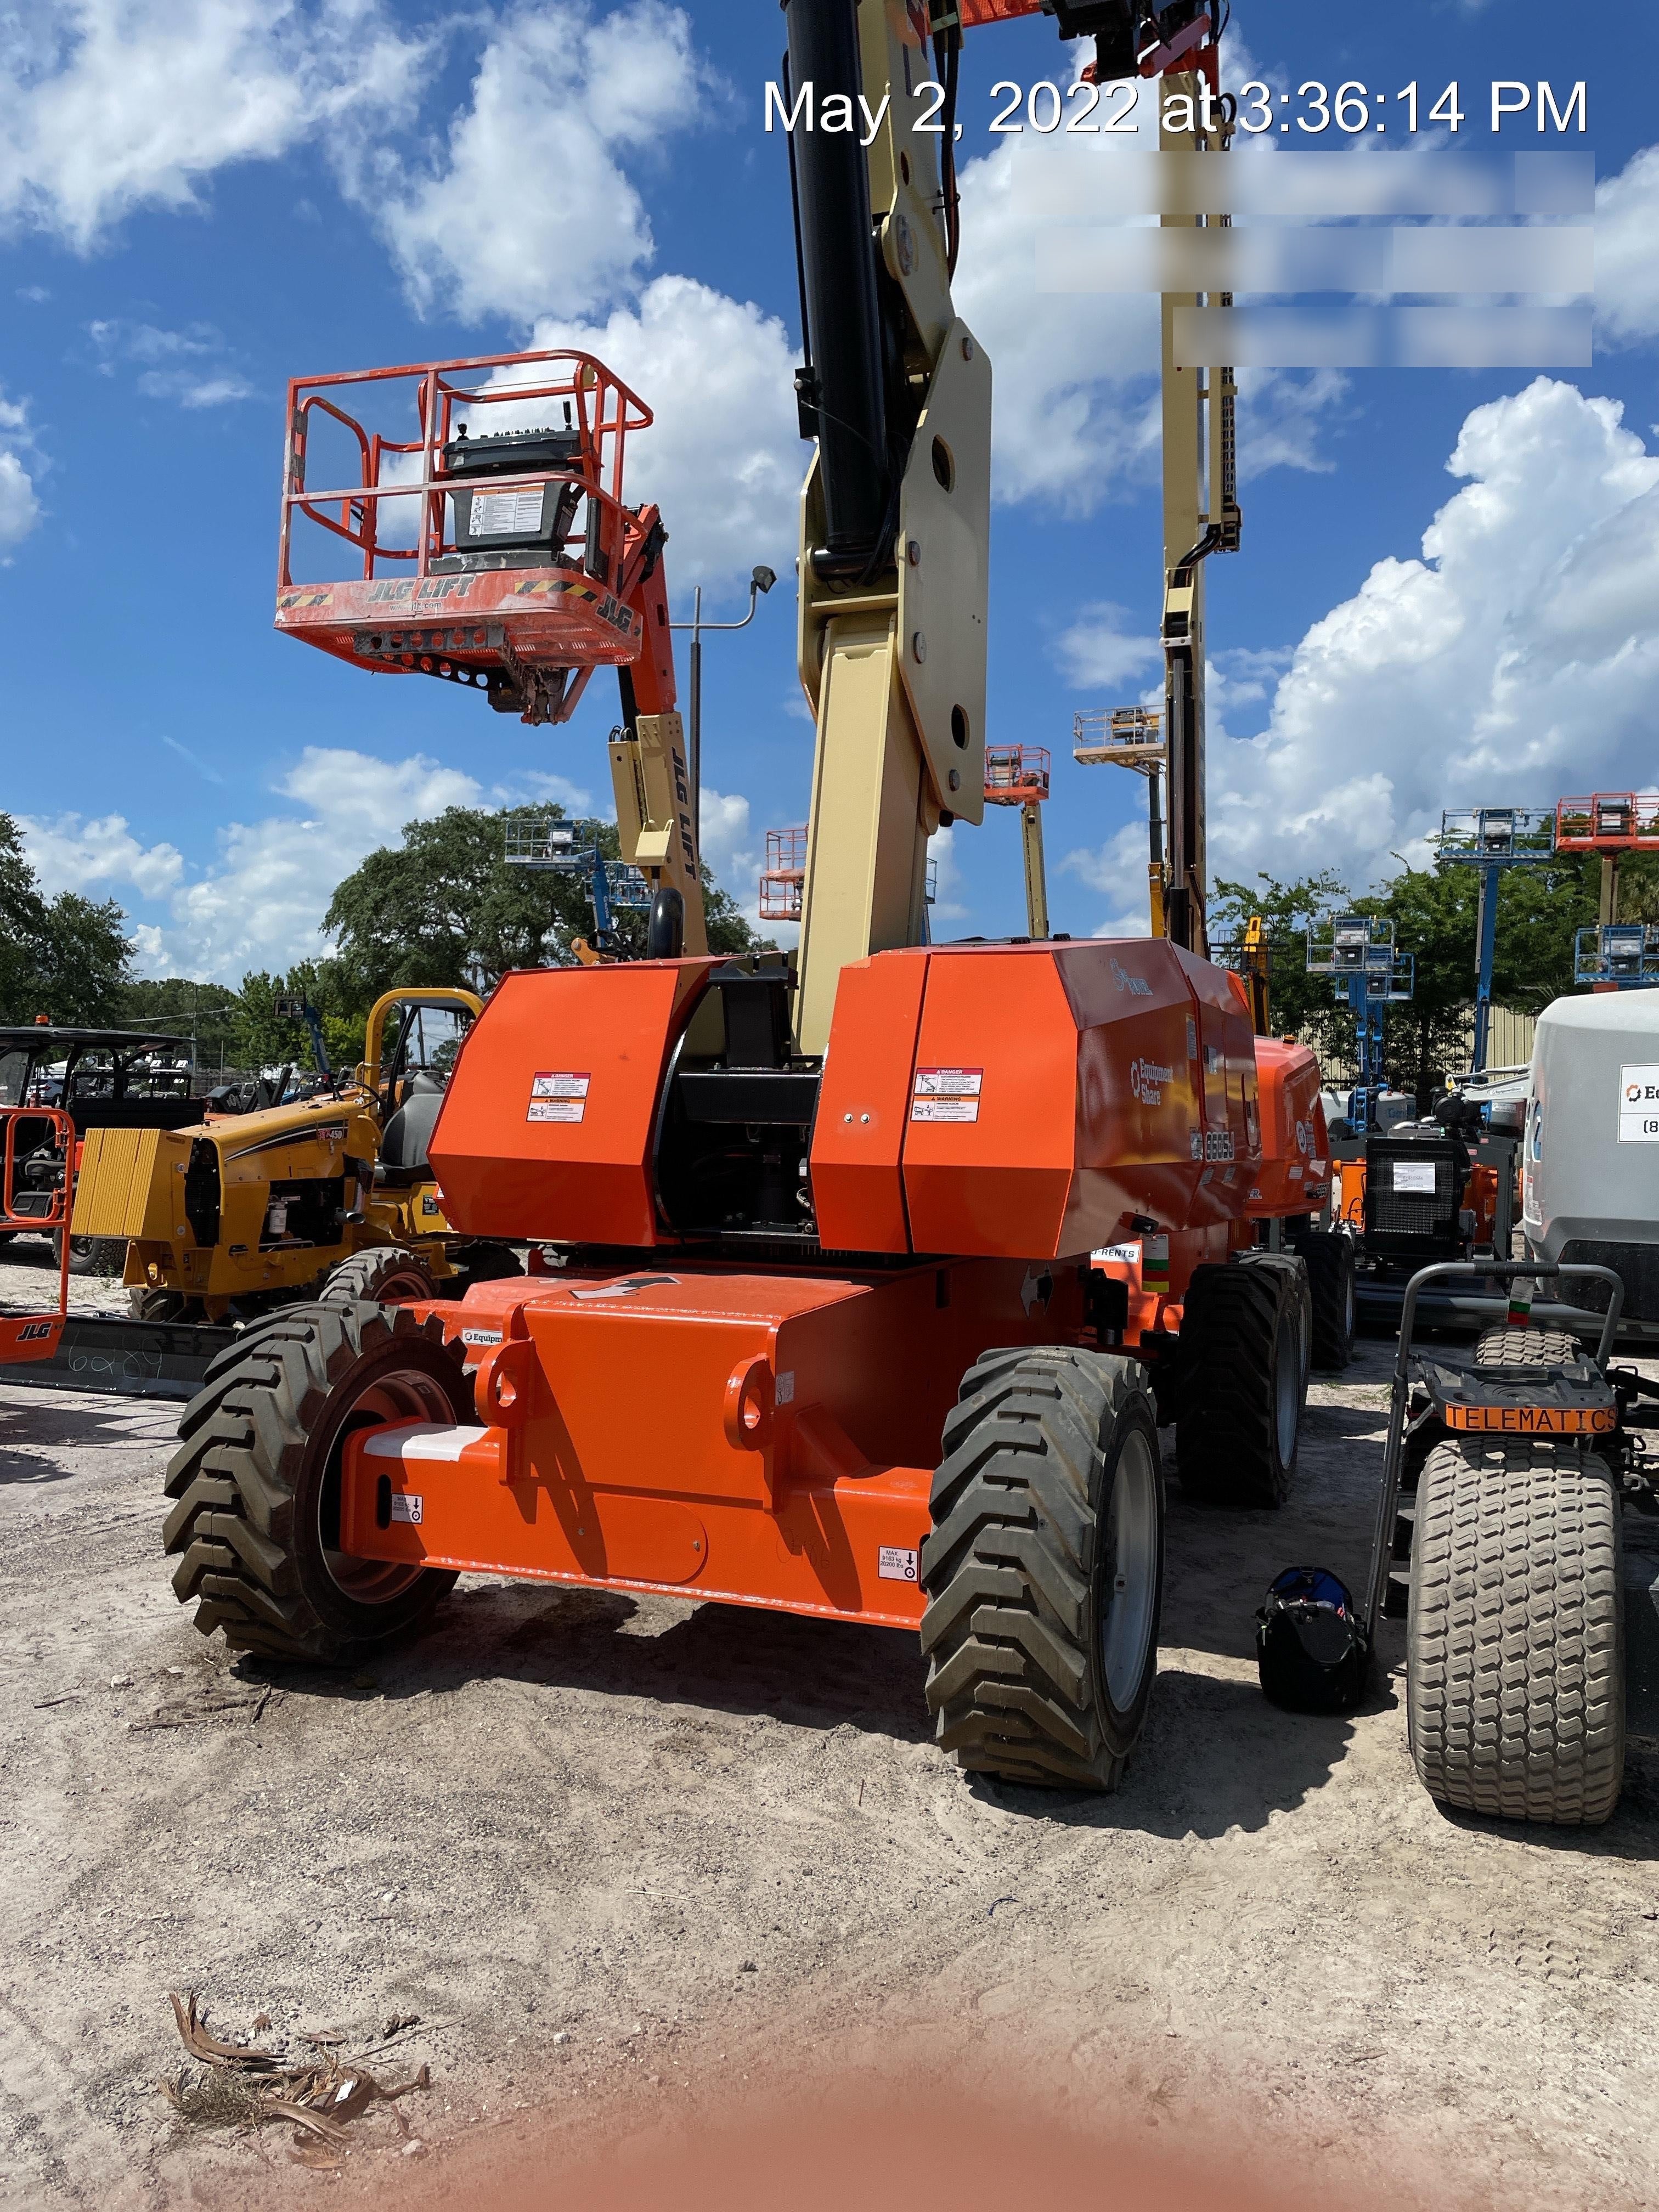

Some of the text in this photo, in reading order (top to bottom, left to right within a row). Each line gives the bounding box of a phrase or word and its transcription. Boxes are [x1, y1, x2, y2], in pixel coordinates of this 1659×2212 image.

[367, 576, 476, 602] JLG LIFT
[595, 593, 634, 635] JLG
[672, 746, 696, 881] JLG LIFT
[1139, 1058, 1174, 1086] Equipment
[1141, 1084, 1161, 1105] Share
[16, 1322, 53, 1342] JLG
[473, 1333, 502, 1344] Equipm
[1447, 1406, 1616, 1431] TELEMATICS
